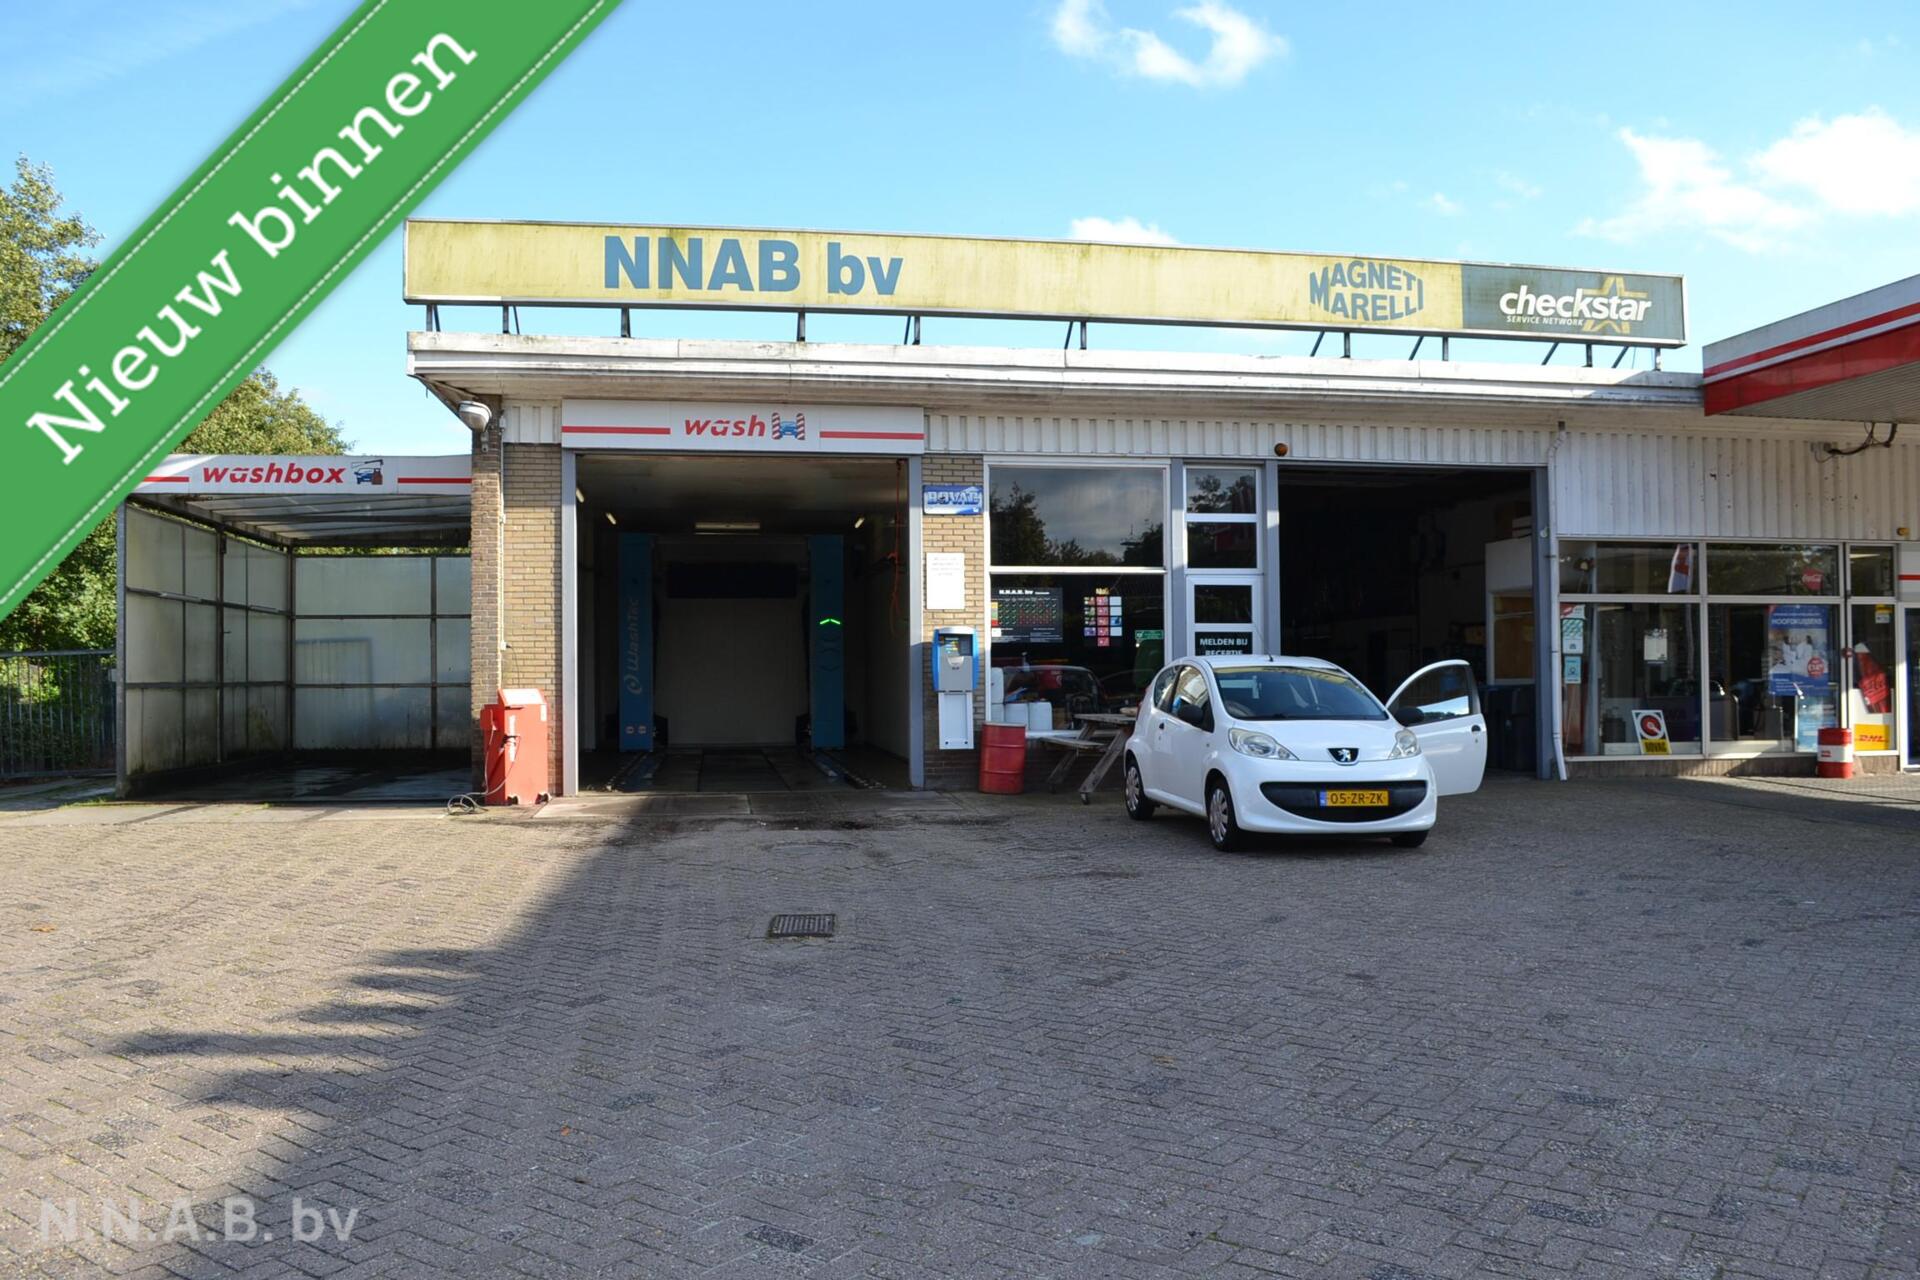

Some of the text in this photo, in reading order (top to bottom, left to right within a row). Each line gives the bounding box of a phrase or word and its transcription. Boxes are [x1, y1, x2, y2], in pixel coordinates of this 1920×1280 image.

[604, 236, 903, 296] NNAB bv
[1309, 260, 1424, 304] MAGNETI
[1309, 278, 1424, 322] MARELLI
[1499, 285, 1652, 321] checkstar
[1506, 315, 1584, 327] SERVICE NETWORK
[684, 415, 766, 437] wash
[203, 463, 346, 484] washbox
[1200, 638, 1234, 646] MELDEN
[1330, 792, 1384, 804] 05-ZR-ZK
